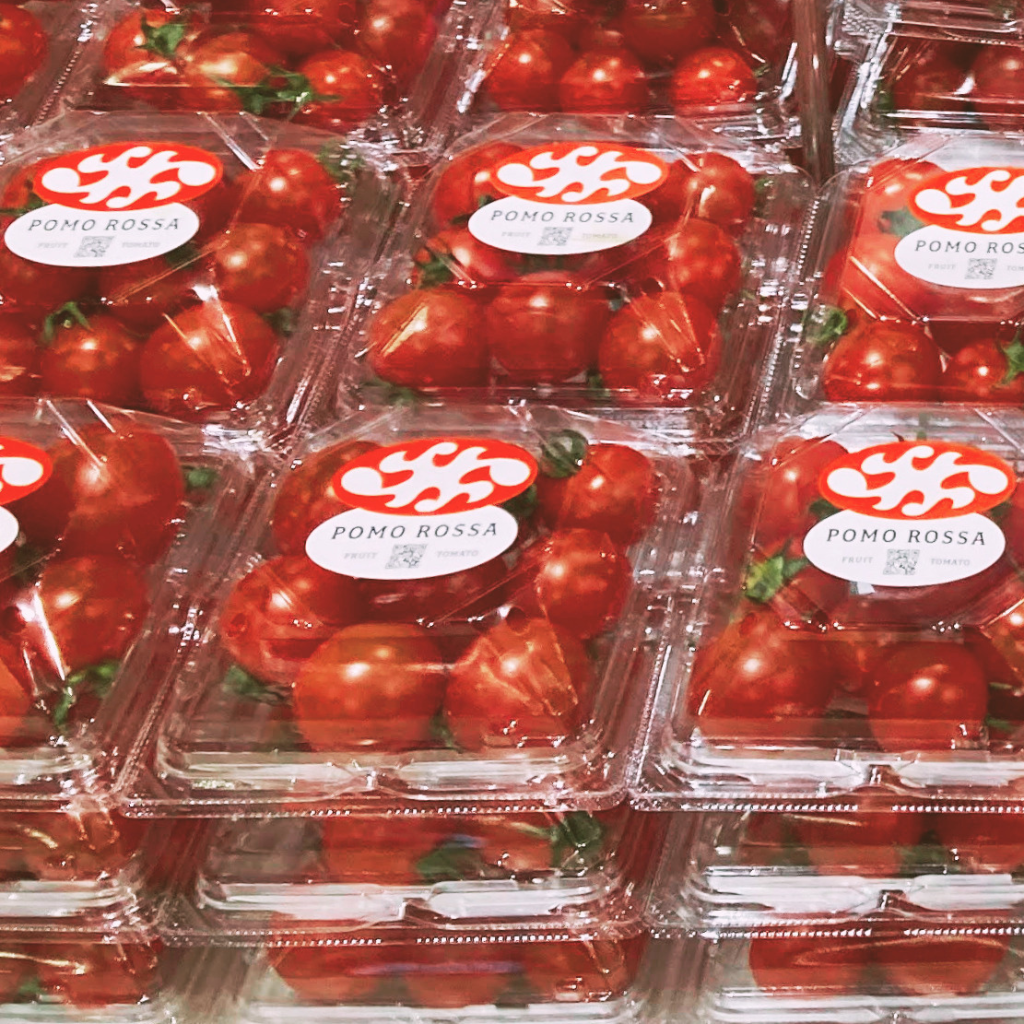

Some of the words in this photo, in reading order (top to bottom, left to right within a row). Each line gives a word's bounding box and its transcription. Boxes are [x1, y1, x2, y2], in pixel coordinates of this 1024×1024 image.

[491, 210, 554, 222] POMO
[563, 212, 634, 223] ROSSA
[28, 219, 96, 231] POMO
[105, 218, 179, 231] ROSSA
[915, 240, 977, 253] POMO
[331, 525, 405, 540] POMO
[416, 523, 497, 537] ROSSA
[827, 529, 896, 543] POMO
[908, 529, 985, 546] ROSSA
